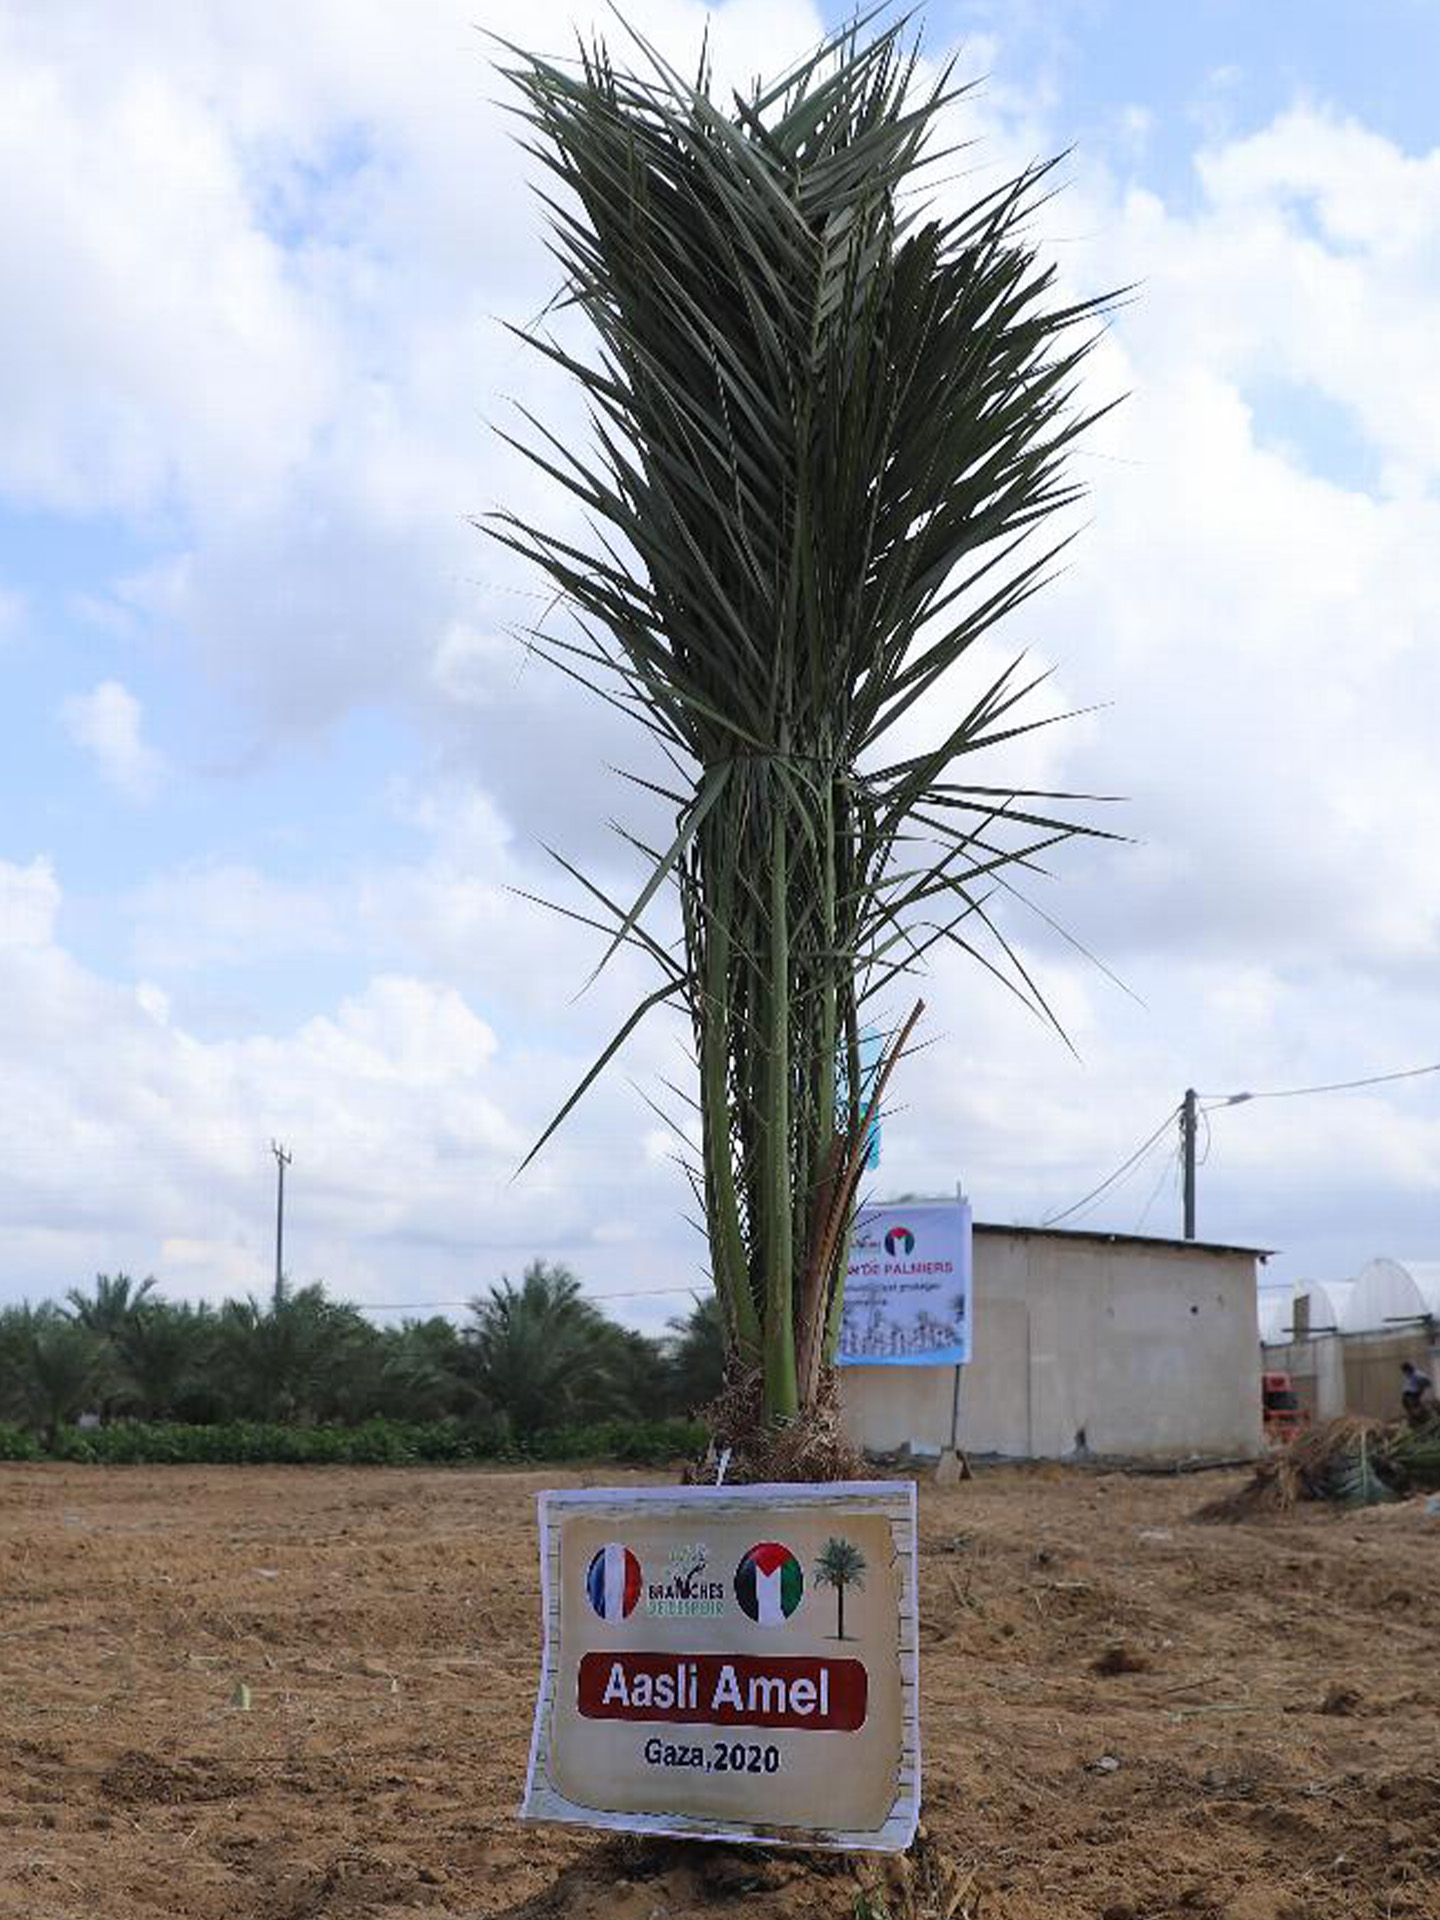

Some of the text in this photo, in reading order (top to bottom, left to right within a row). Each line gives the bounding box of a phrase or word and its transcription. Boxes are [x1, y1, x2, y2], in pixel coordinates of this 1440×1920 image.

[884, 1262, 954, 1276] PALMIERS
[648, 1582, 724, 1599] BRANCHES
[602, 1661, 830, 1716] Aasli Amel
